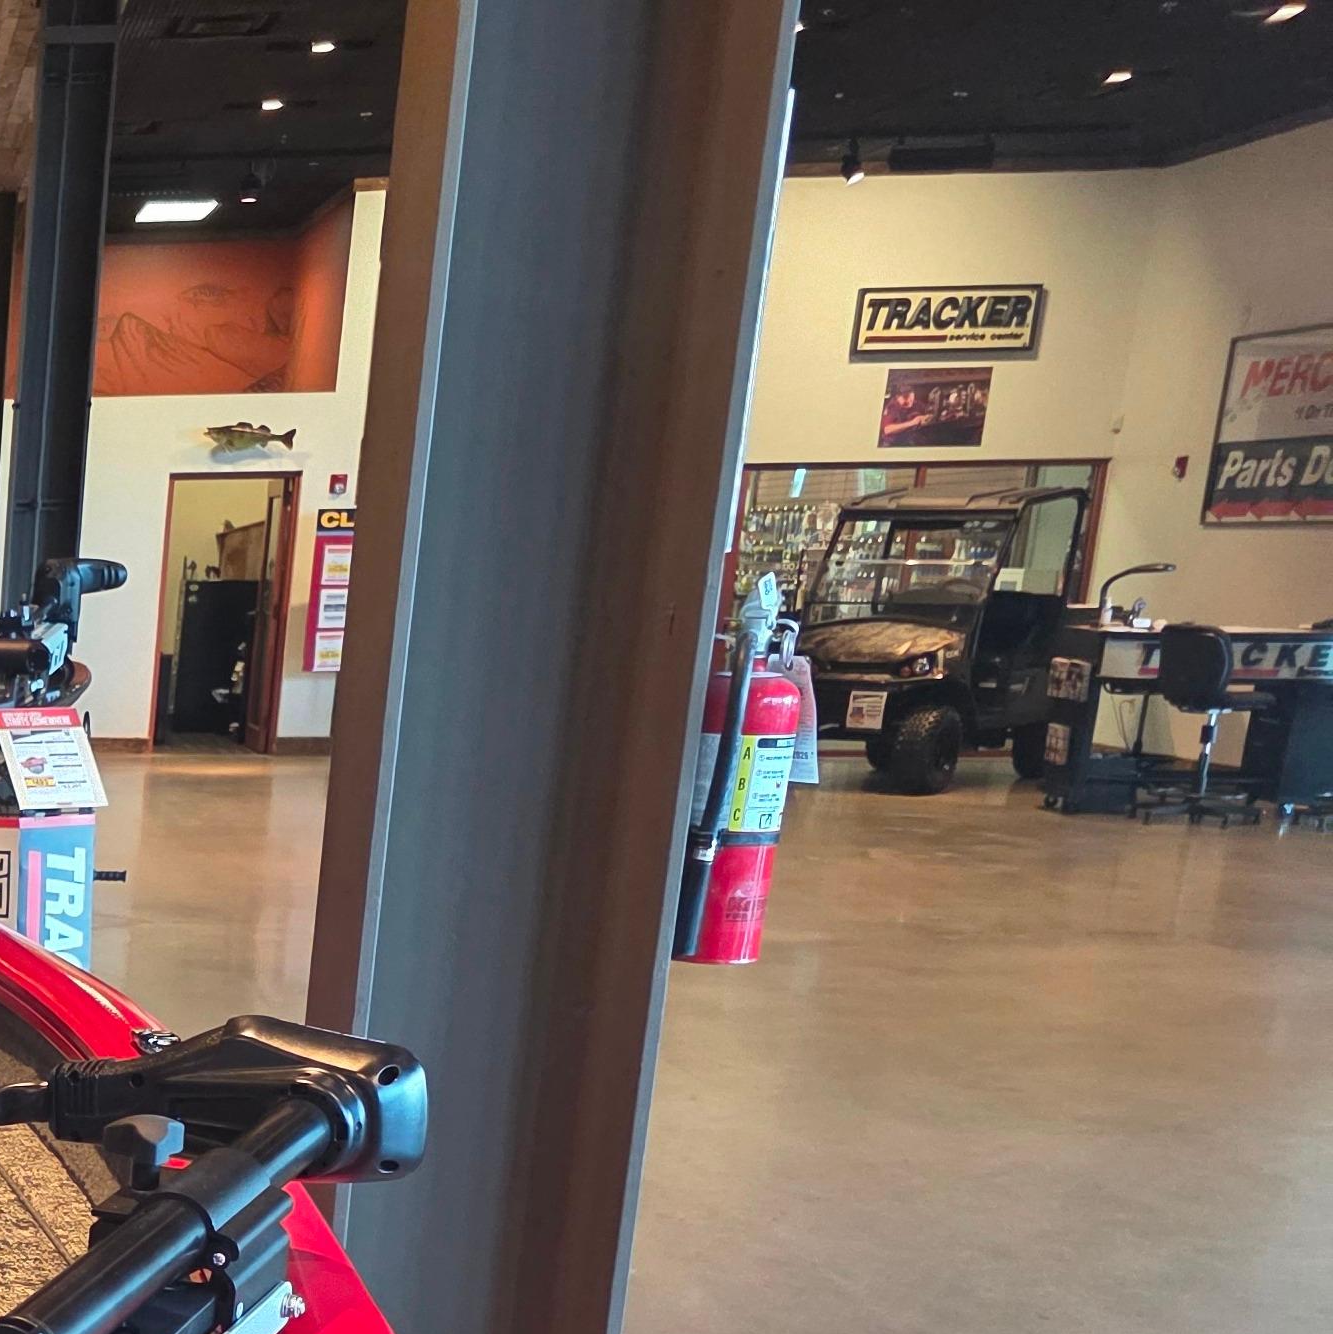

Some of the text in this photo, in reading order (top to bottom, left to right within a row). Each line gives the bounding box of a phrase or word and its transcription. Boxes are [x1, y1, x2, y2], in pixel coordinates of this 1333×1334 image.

[866, 296, 1033, 332] TRACKER
[948, 332, 1024, 341] service center
[1217, 448, 1297, 490] Parts
[320, 511, 356, 528] CL
[743, 746, 751, 760] A
[738, 777, 746, 791] B
[733, 807, 741, 821] C
